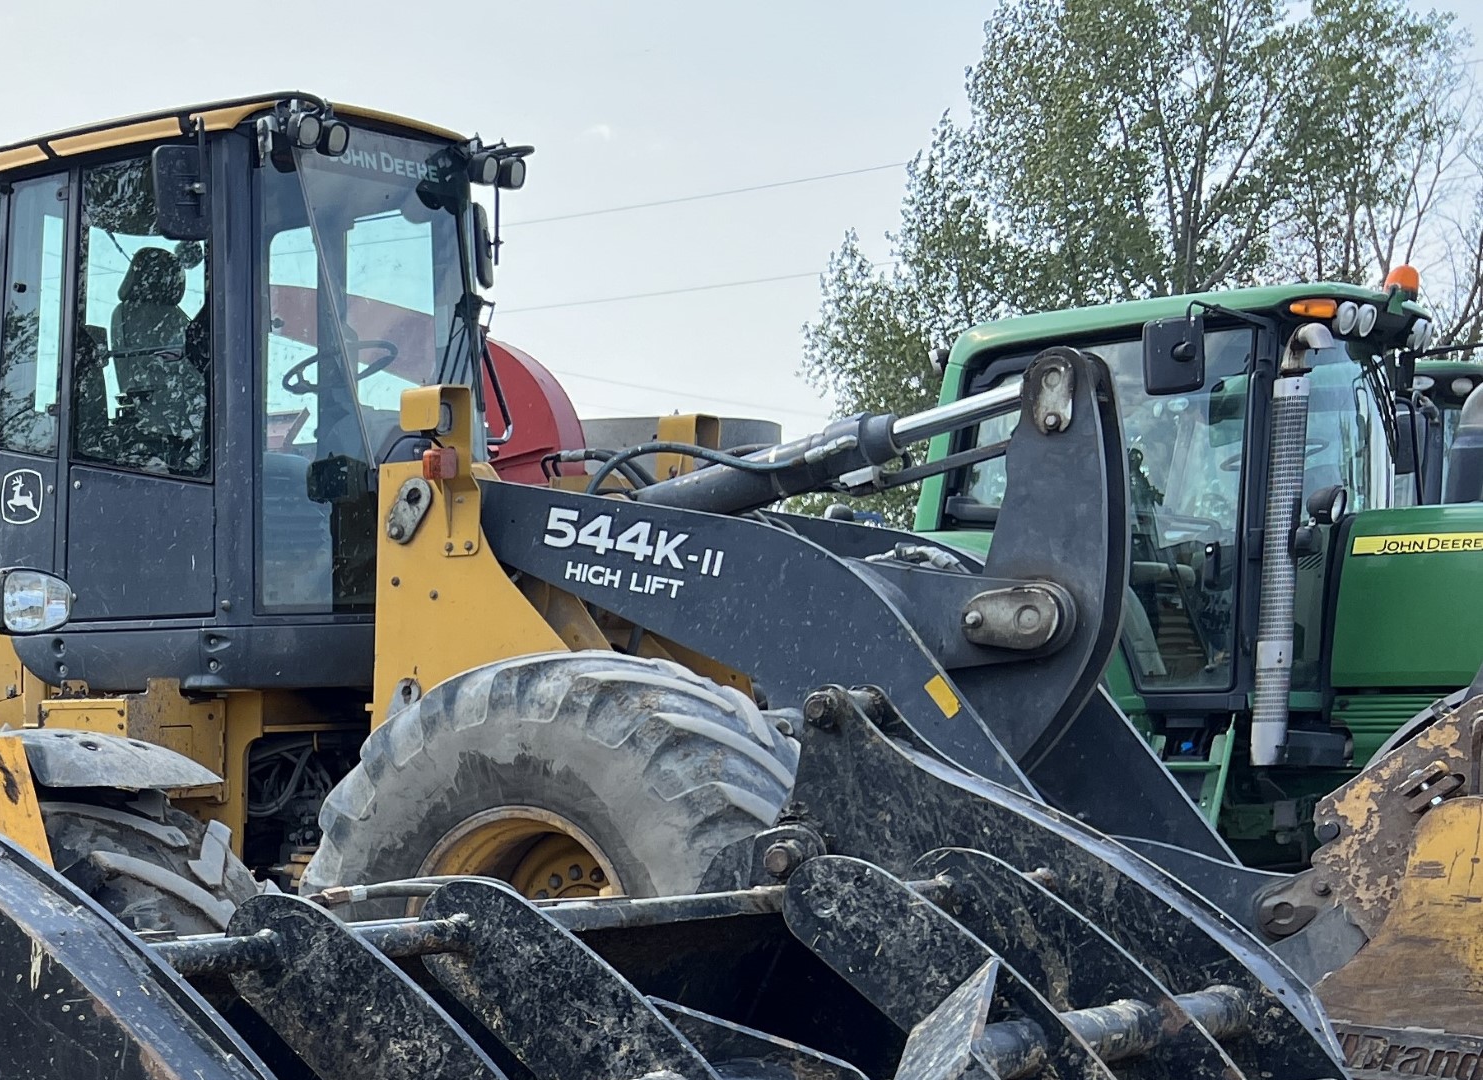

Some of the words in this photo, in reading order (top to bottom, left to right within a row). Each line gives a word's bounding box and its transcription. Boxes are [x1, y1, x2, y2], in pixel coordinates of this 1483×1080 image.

[329, 149, 378, 171] OHN
[379, 151, 440, 184] DEERE
[543, 506, 725, 578] 544K-II
[1376, 539, 1425, 553] JOHN
[1427, 537, 1483, 550] DEERE
[564, 560, 622, 589] HIGH
[629, 572, 685, 600] LIFT
